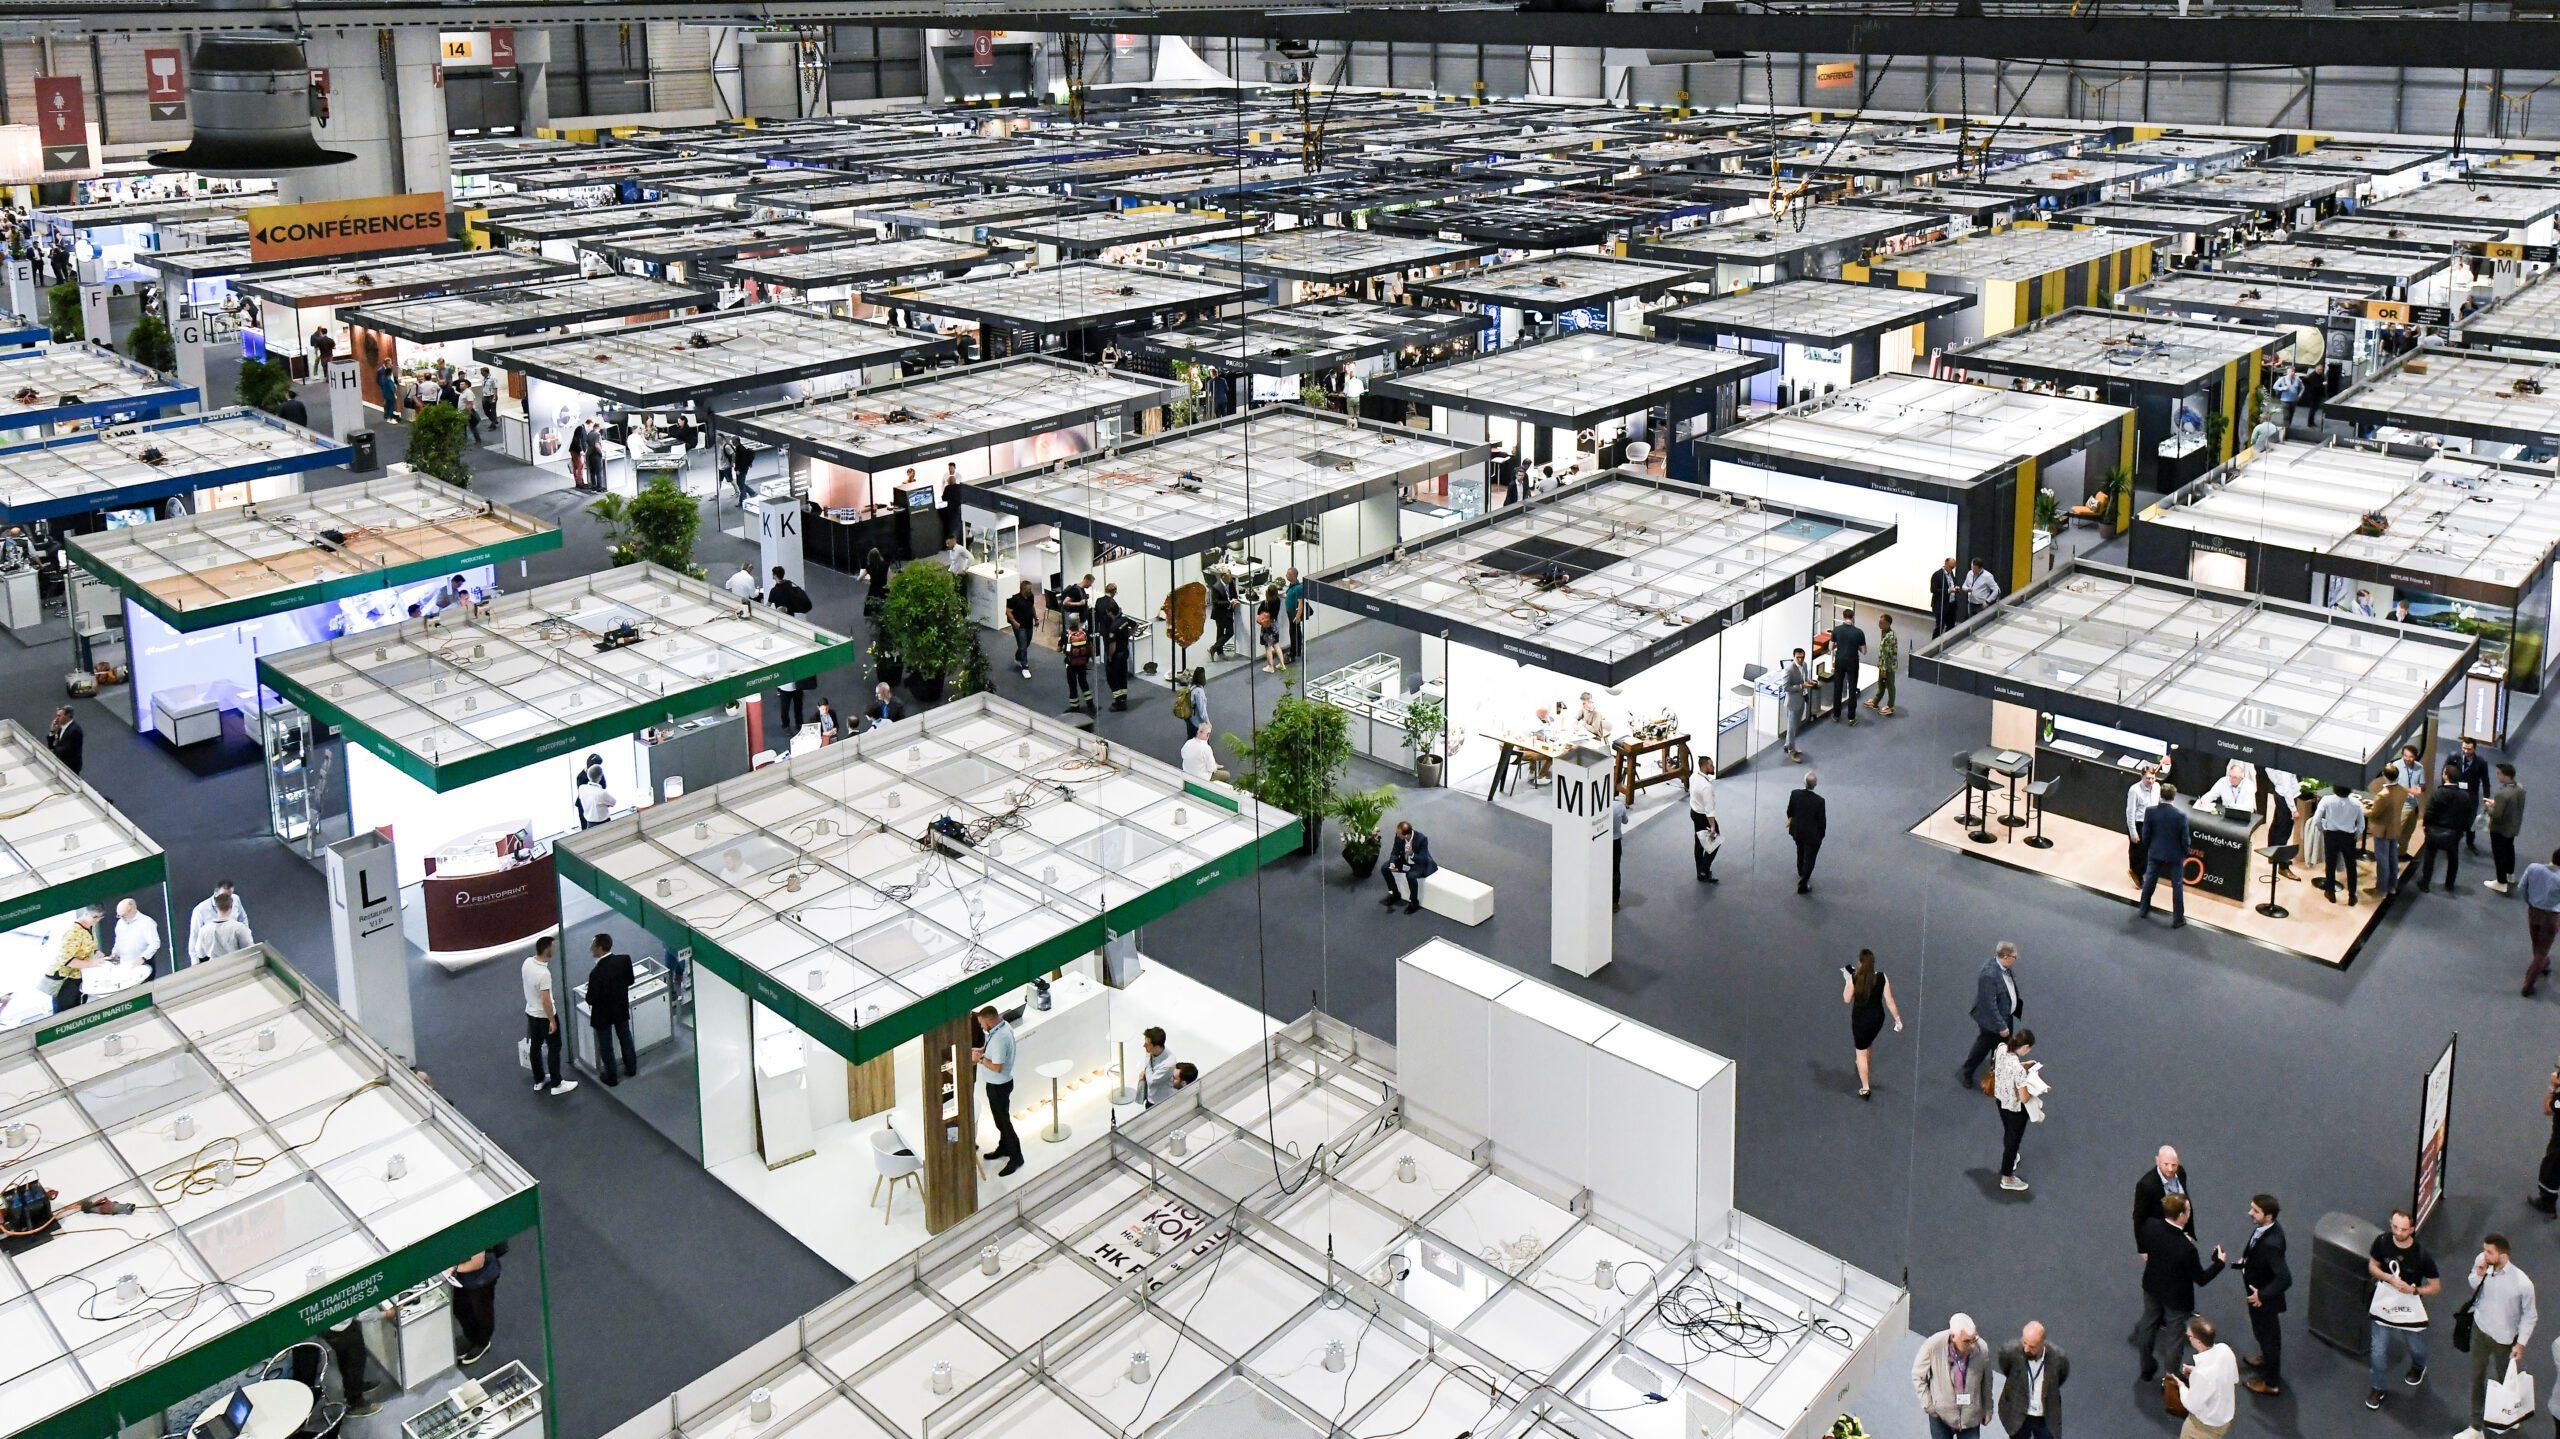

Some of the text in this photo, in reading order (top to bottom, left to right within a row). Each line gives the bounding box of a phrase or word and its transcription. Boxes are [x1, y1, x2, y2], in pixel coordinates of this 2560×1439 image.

[449, 43, 464, 56] 14
[269, 211, 442, 244] CONFÉRENCES
[2301, 214, 2307, 225] L
[18, 267, 28, 280] E
[2498, 260, 2511, 273] M
[92, 292, 101, 306] F
[2379, 309, 2397, 318] OR
[183, 328, 197, 343] G
[342, 371, 356, 389] H
[763, 512, 772, 537] K
[781, 511, 796, 537] K
[2192, 541, 2247, 558] Promotion Group
[461, 556, 484, 564] PRODUCTEC
[747, 675, 773, 687] FEMTOPRINT
[1994, 685, 2024, 697] Louis Laurent
[537, 739, 568, 753] FEMTOPRINT
[2217, 740, 2254, 754] Cristofol ASF
[1558, 774, 1583, 817] M
[1591, 774, 1610, 817] M
[2203, 874, 2224, 885] 2023
[359, 869, 387, 909] L
[472, 885, 527, 903] FEMTOPRINT
[359, 905, 393, 922] Restaurant
[56, 1003, 133, 1034] FONDATION INARTIS
[1095, 1243, 1130, 1269] HK
[298, 1271, 384, 1319] TTM TRAITEMENTS
[305, 1285, 379, 1327] THERMIQUES SA
